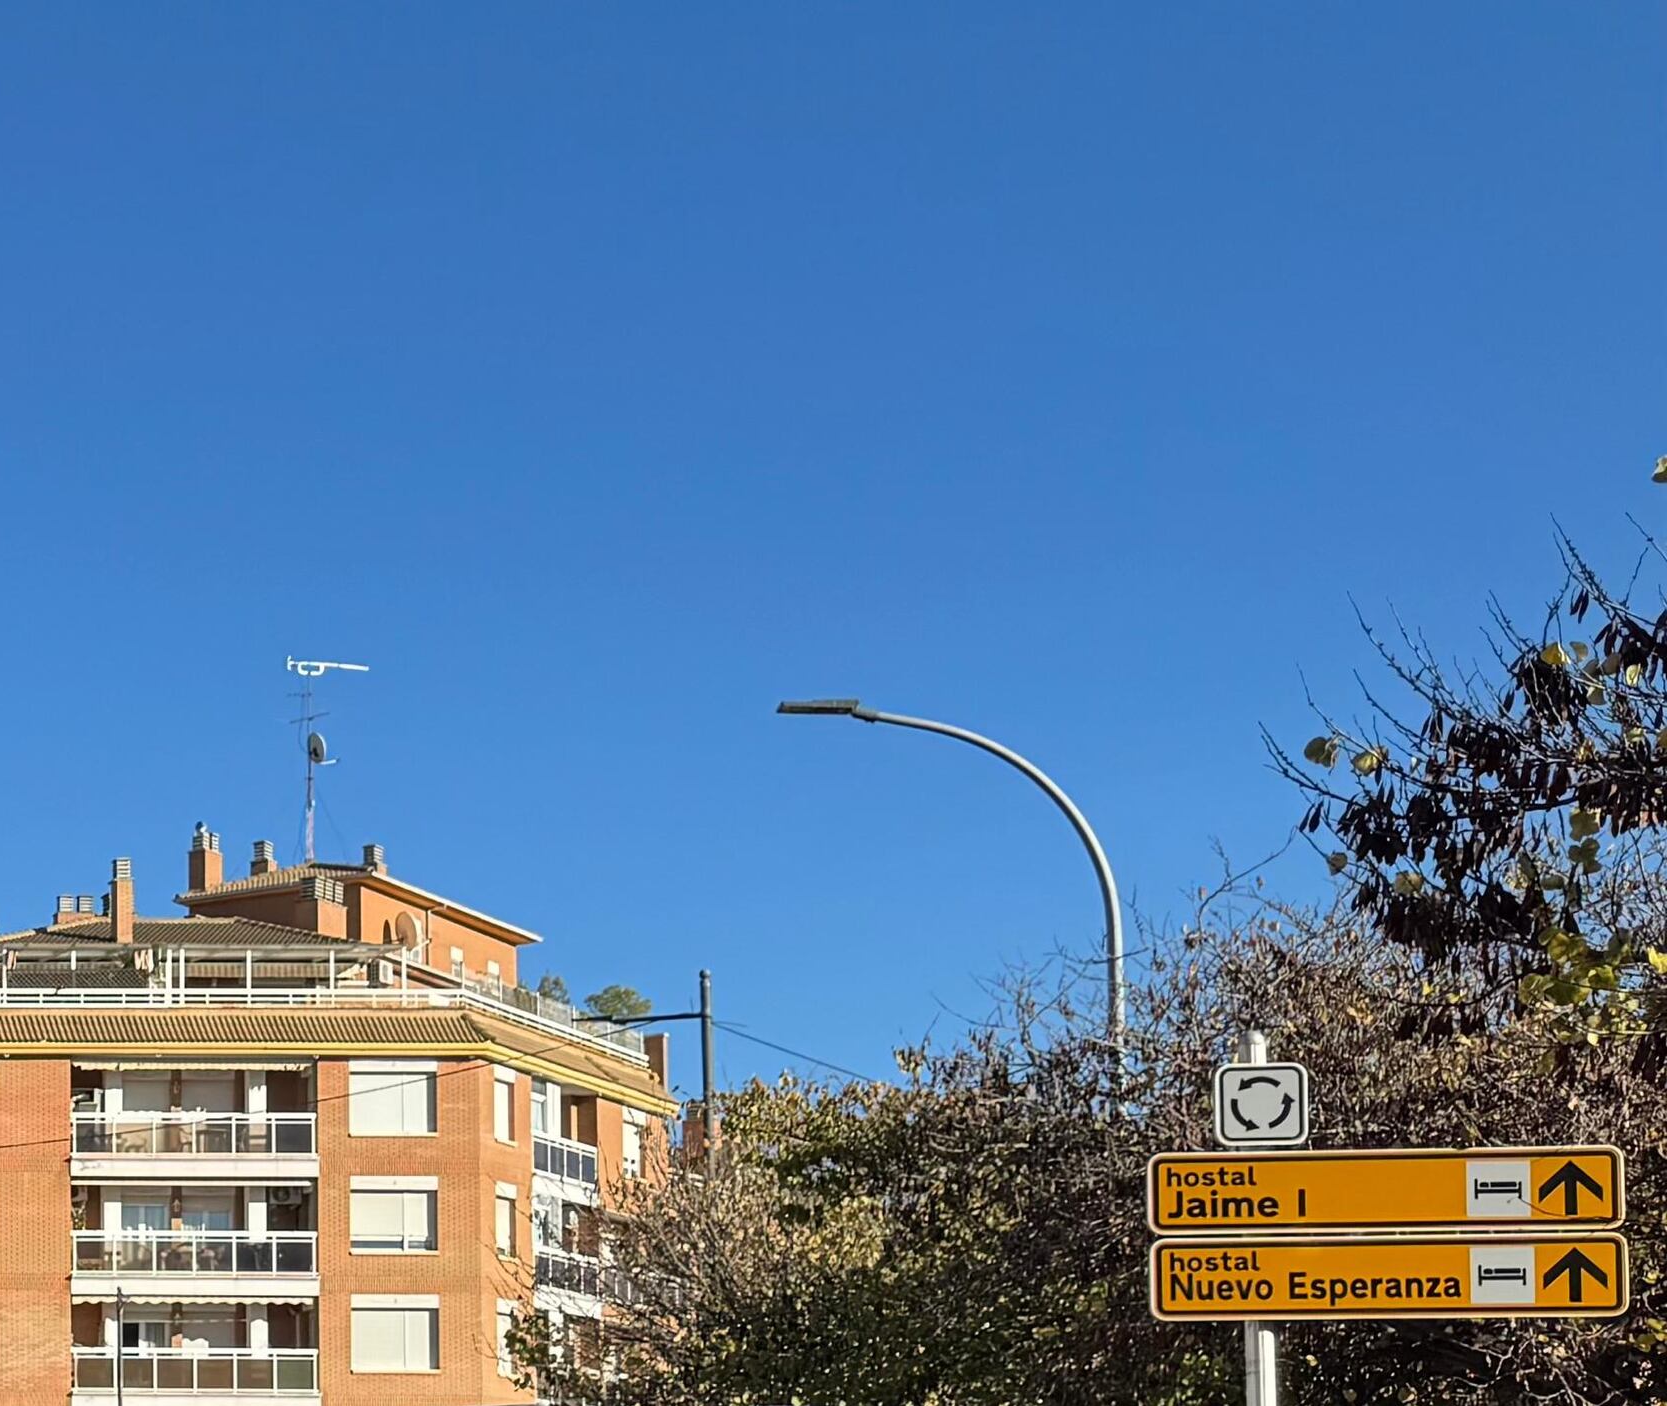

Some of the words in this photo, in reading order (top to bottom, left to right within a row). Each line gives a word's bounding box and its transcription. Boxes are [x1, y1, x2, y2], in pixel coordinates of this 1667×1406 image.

[1166, 1167, 1257, 1188] hostal
[1166, 1188, 1280, 1219] Jaime
[1297, 1188, 1307, 1217] I
[1169, 1251, 1260, 1273] hostal
[1169, 1274, 1274, 1302] Nuevo
[1289, 1273, 1462, 1307] Esperanza
